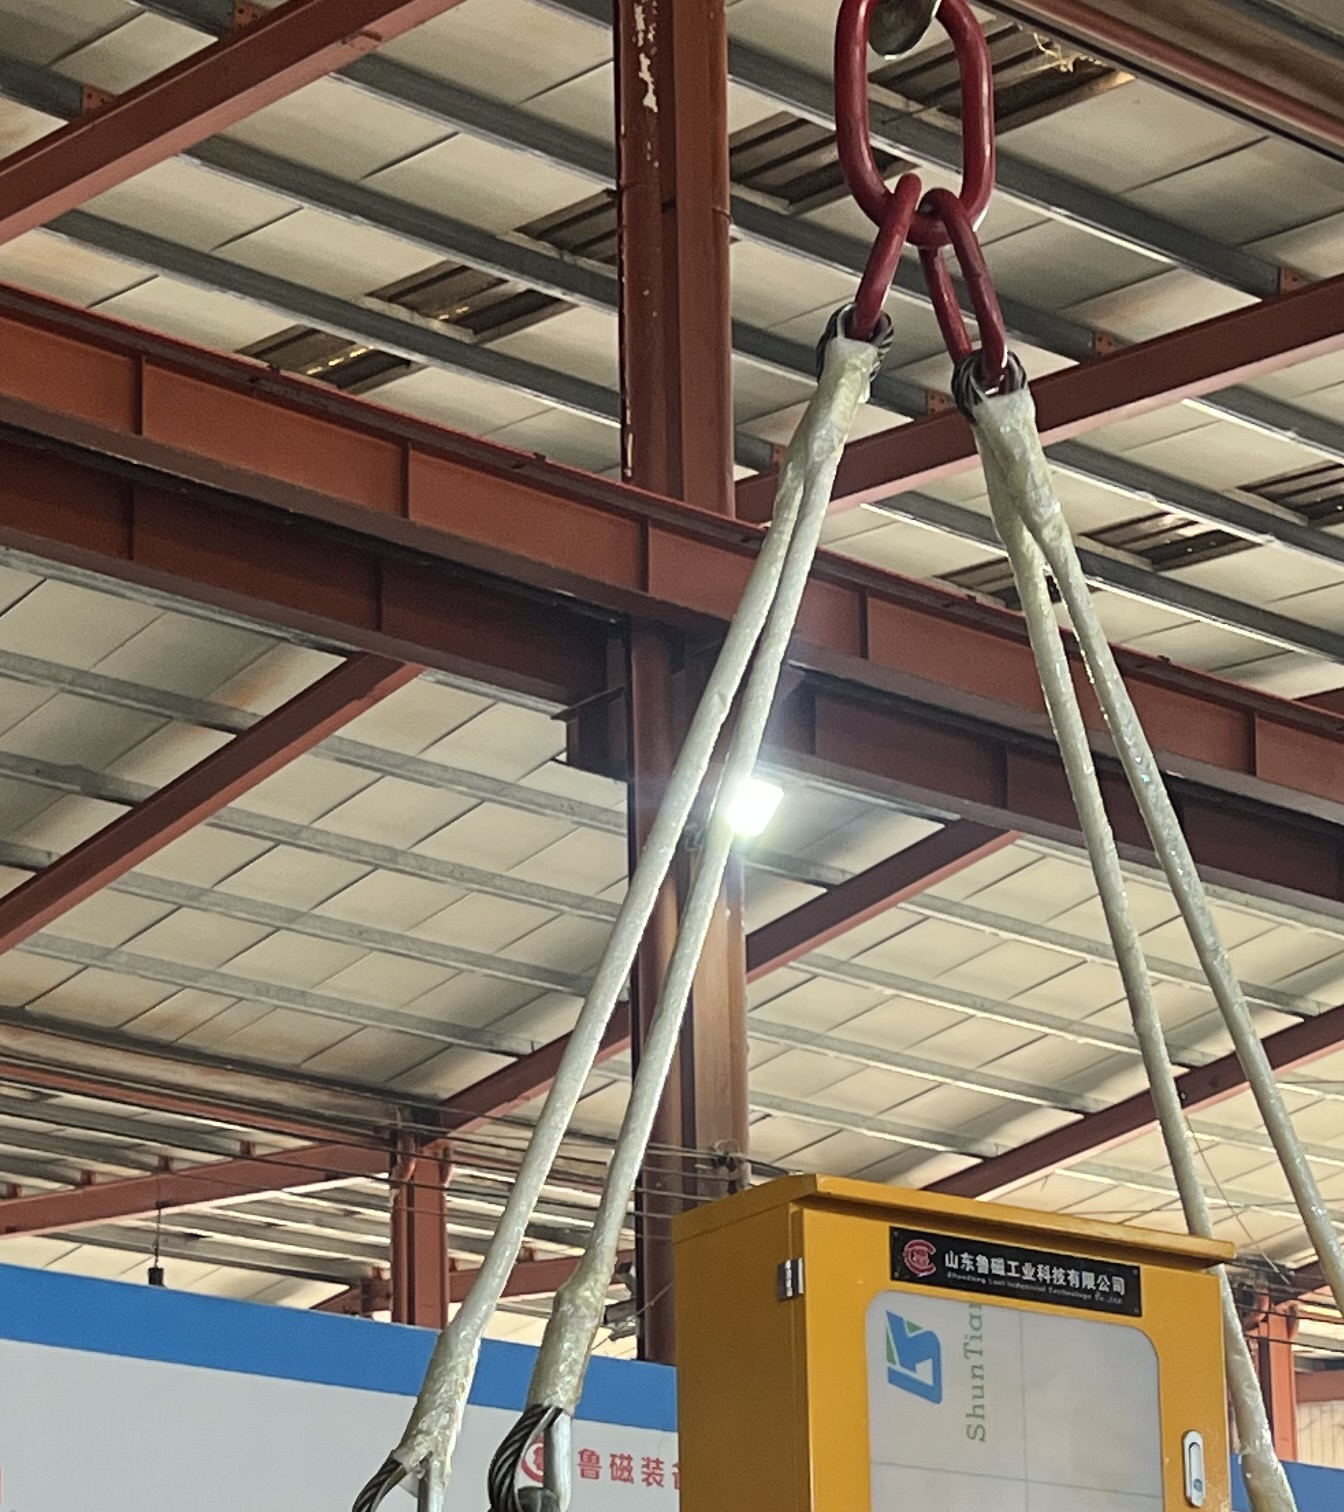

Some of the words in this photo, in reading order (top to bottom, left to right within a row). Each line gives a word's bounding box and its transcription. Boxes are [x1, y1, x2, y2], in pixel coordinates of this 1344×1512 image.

[944, 1250, 1126, 1296] 山东鲁磁工业科技有限公司
